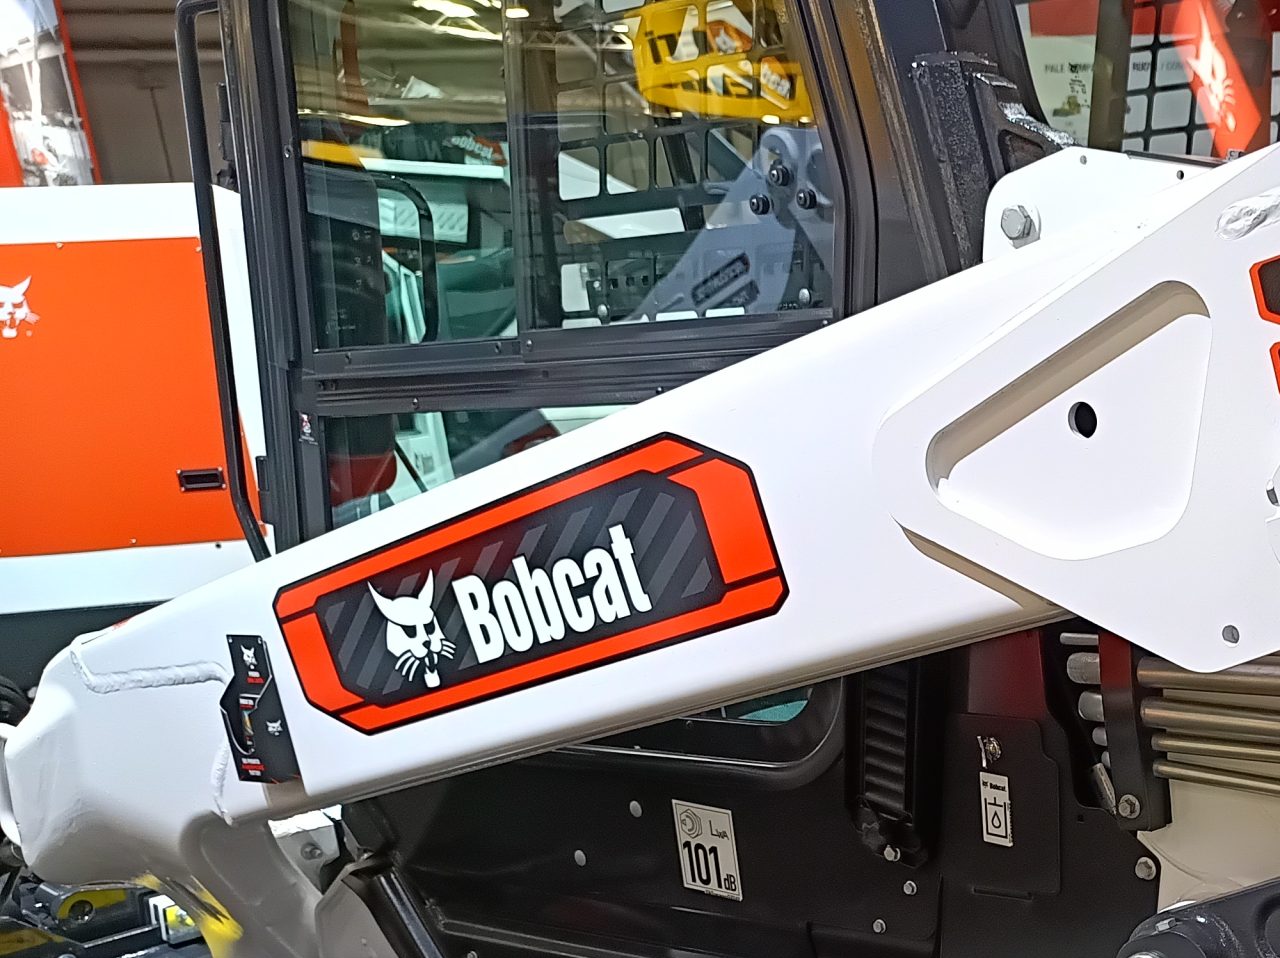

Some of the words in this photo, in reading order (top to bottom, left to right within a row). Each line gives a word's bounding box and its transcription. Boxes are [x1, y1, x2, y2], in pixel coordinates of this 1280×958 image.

[451, 523, 653, 664] Bobcat
[682, 840, 723, 889] 101
[723, 873, 737, 892] dB
